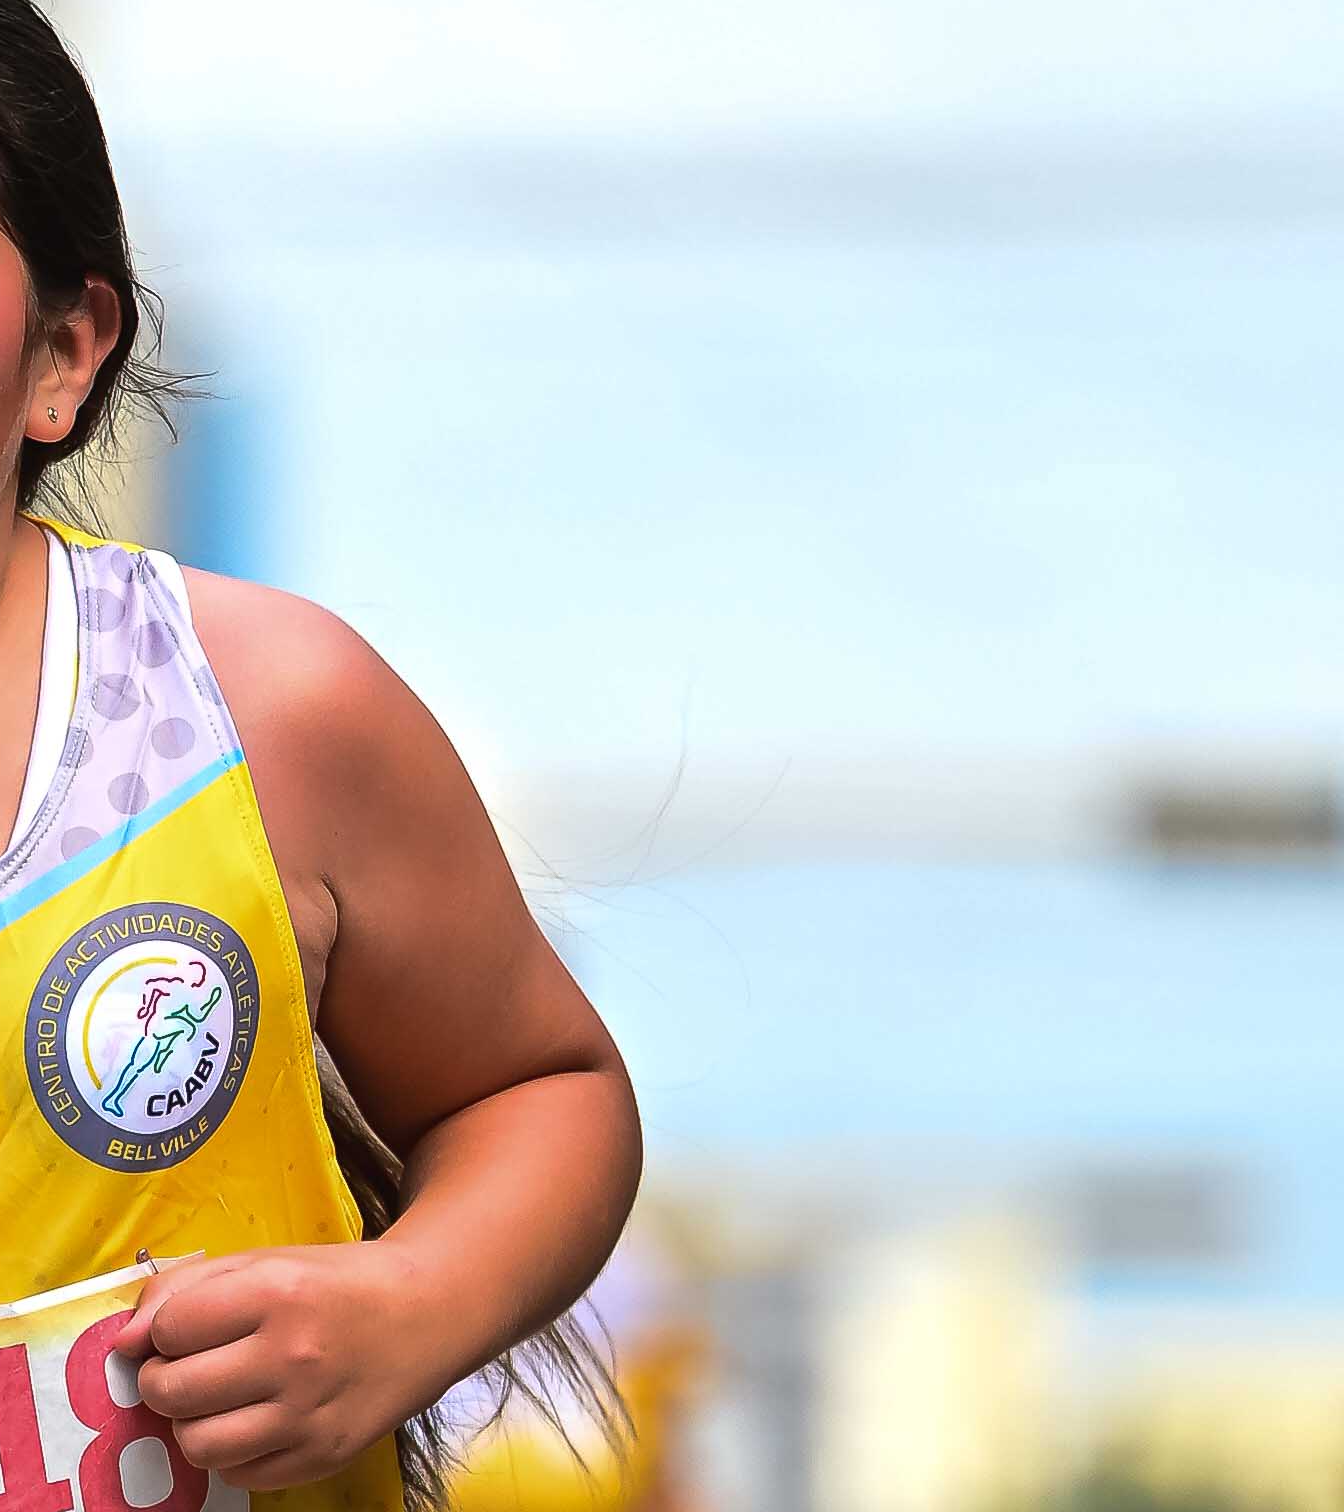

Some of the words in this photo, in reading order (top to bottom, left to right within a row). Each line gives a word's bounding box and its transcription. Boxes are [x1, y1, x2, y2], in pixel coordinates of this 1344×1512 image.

[64, 913, 225, 978] ACTIVIDADES
[41, 976, 71, 1014] DE
[222, 950, 255, 1092] ATLÉTICAS
[37, 1019, 82, 1128] CENTRO
[146, 1031, 221, 1117] CAABV
[107, 1138, 157, 1161] BELL
[160, 1115, 210, 1158] VILLE
